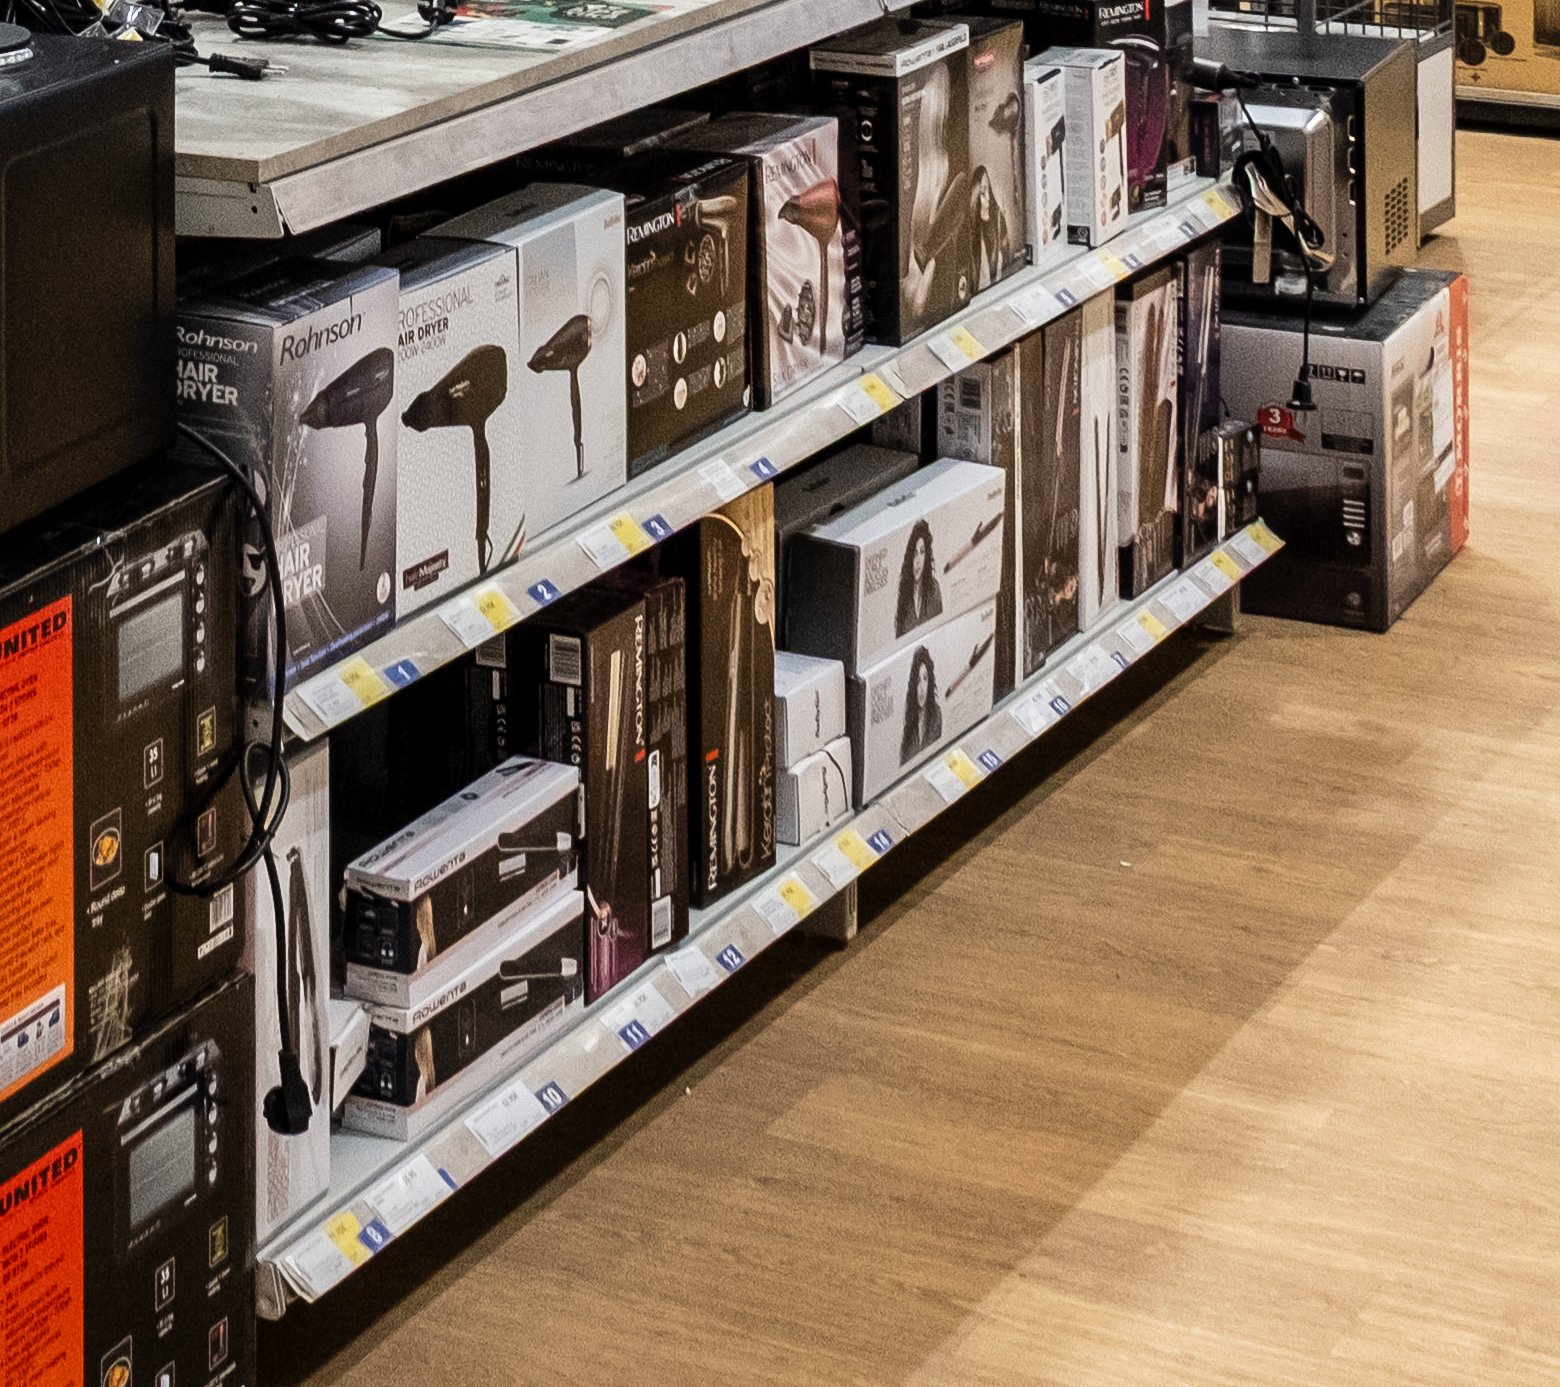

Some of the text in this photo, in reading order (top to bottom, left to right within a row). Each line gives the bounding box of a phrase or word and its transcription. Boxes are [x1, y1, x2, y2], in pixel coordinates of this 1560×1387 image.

[626, 211, 676, 246] REMINGTON
[279, 313, 364, 367] Rohnson
[417, 317, 450, 341] DRYER
[1268, 408, 1282, 424] 3
[537, 582, 553, 600] 2
[397, 664, 411, 680] 1
[633, 613, 646, 747] REMINGTON
[706, 764, 719, 892] REMINGTON
[721, 950, 743, 967] 12
[625, 1026, 648, 1045] 11
[541, 1086, 562, 1108] 10
